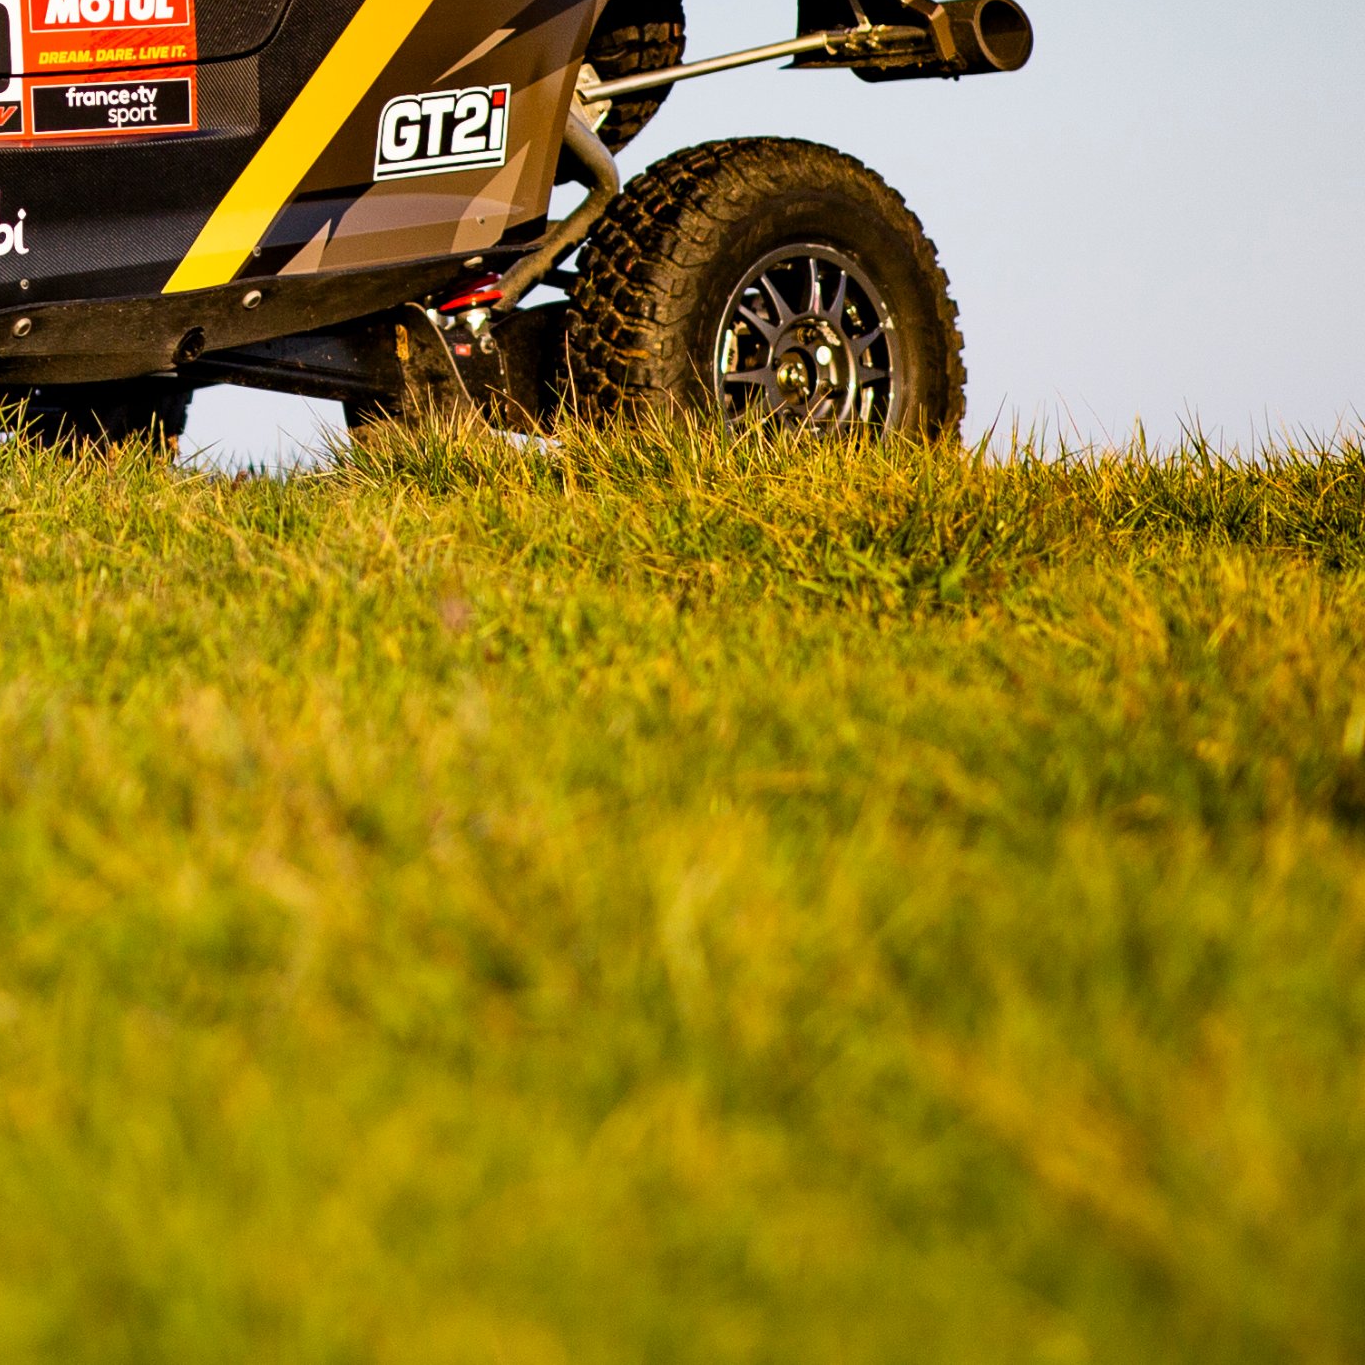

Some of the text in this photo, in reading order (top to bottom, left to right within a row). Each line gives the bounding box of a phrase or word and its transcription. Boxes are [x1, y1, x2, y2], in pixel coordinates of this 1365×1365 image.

[38, 45, 187, 65] DREAM. DARE. LIVE IT.
[108, 104, 157, 128] sport
[380, 89, 506, 162] GT2i
